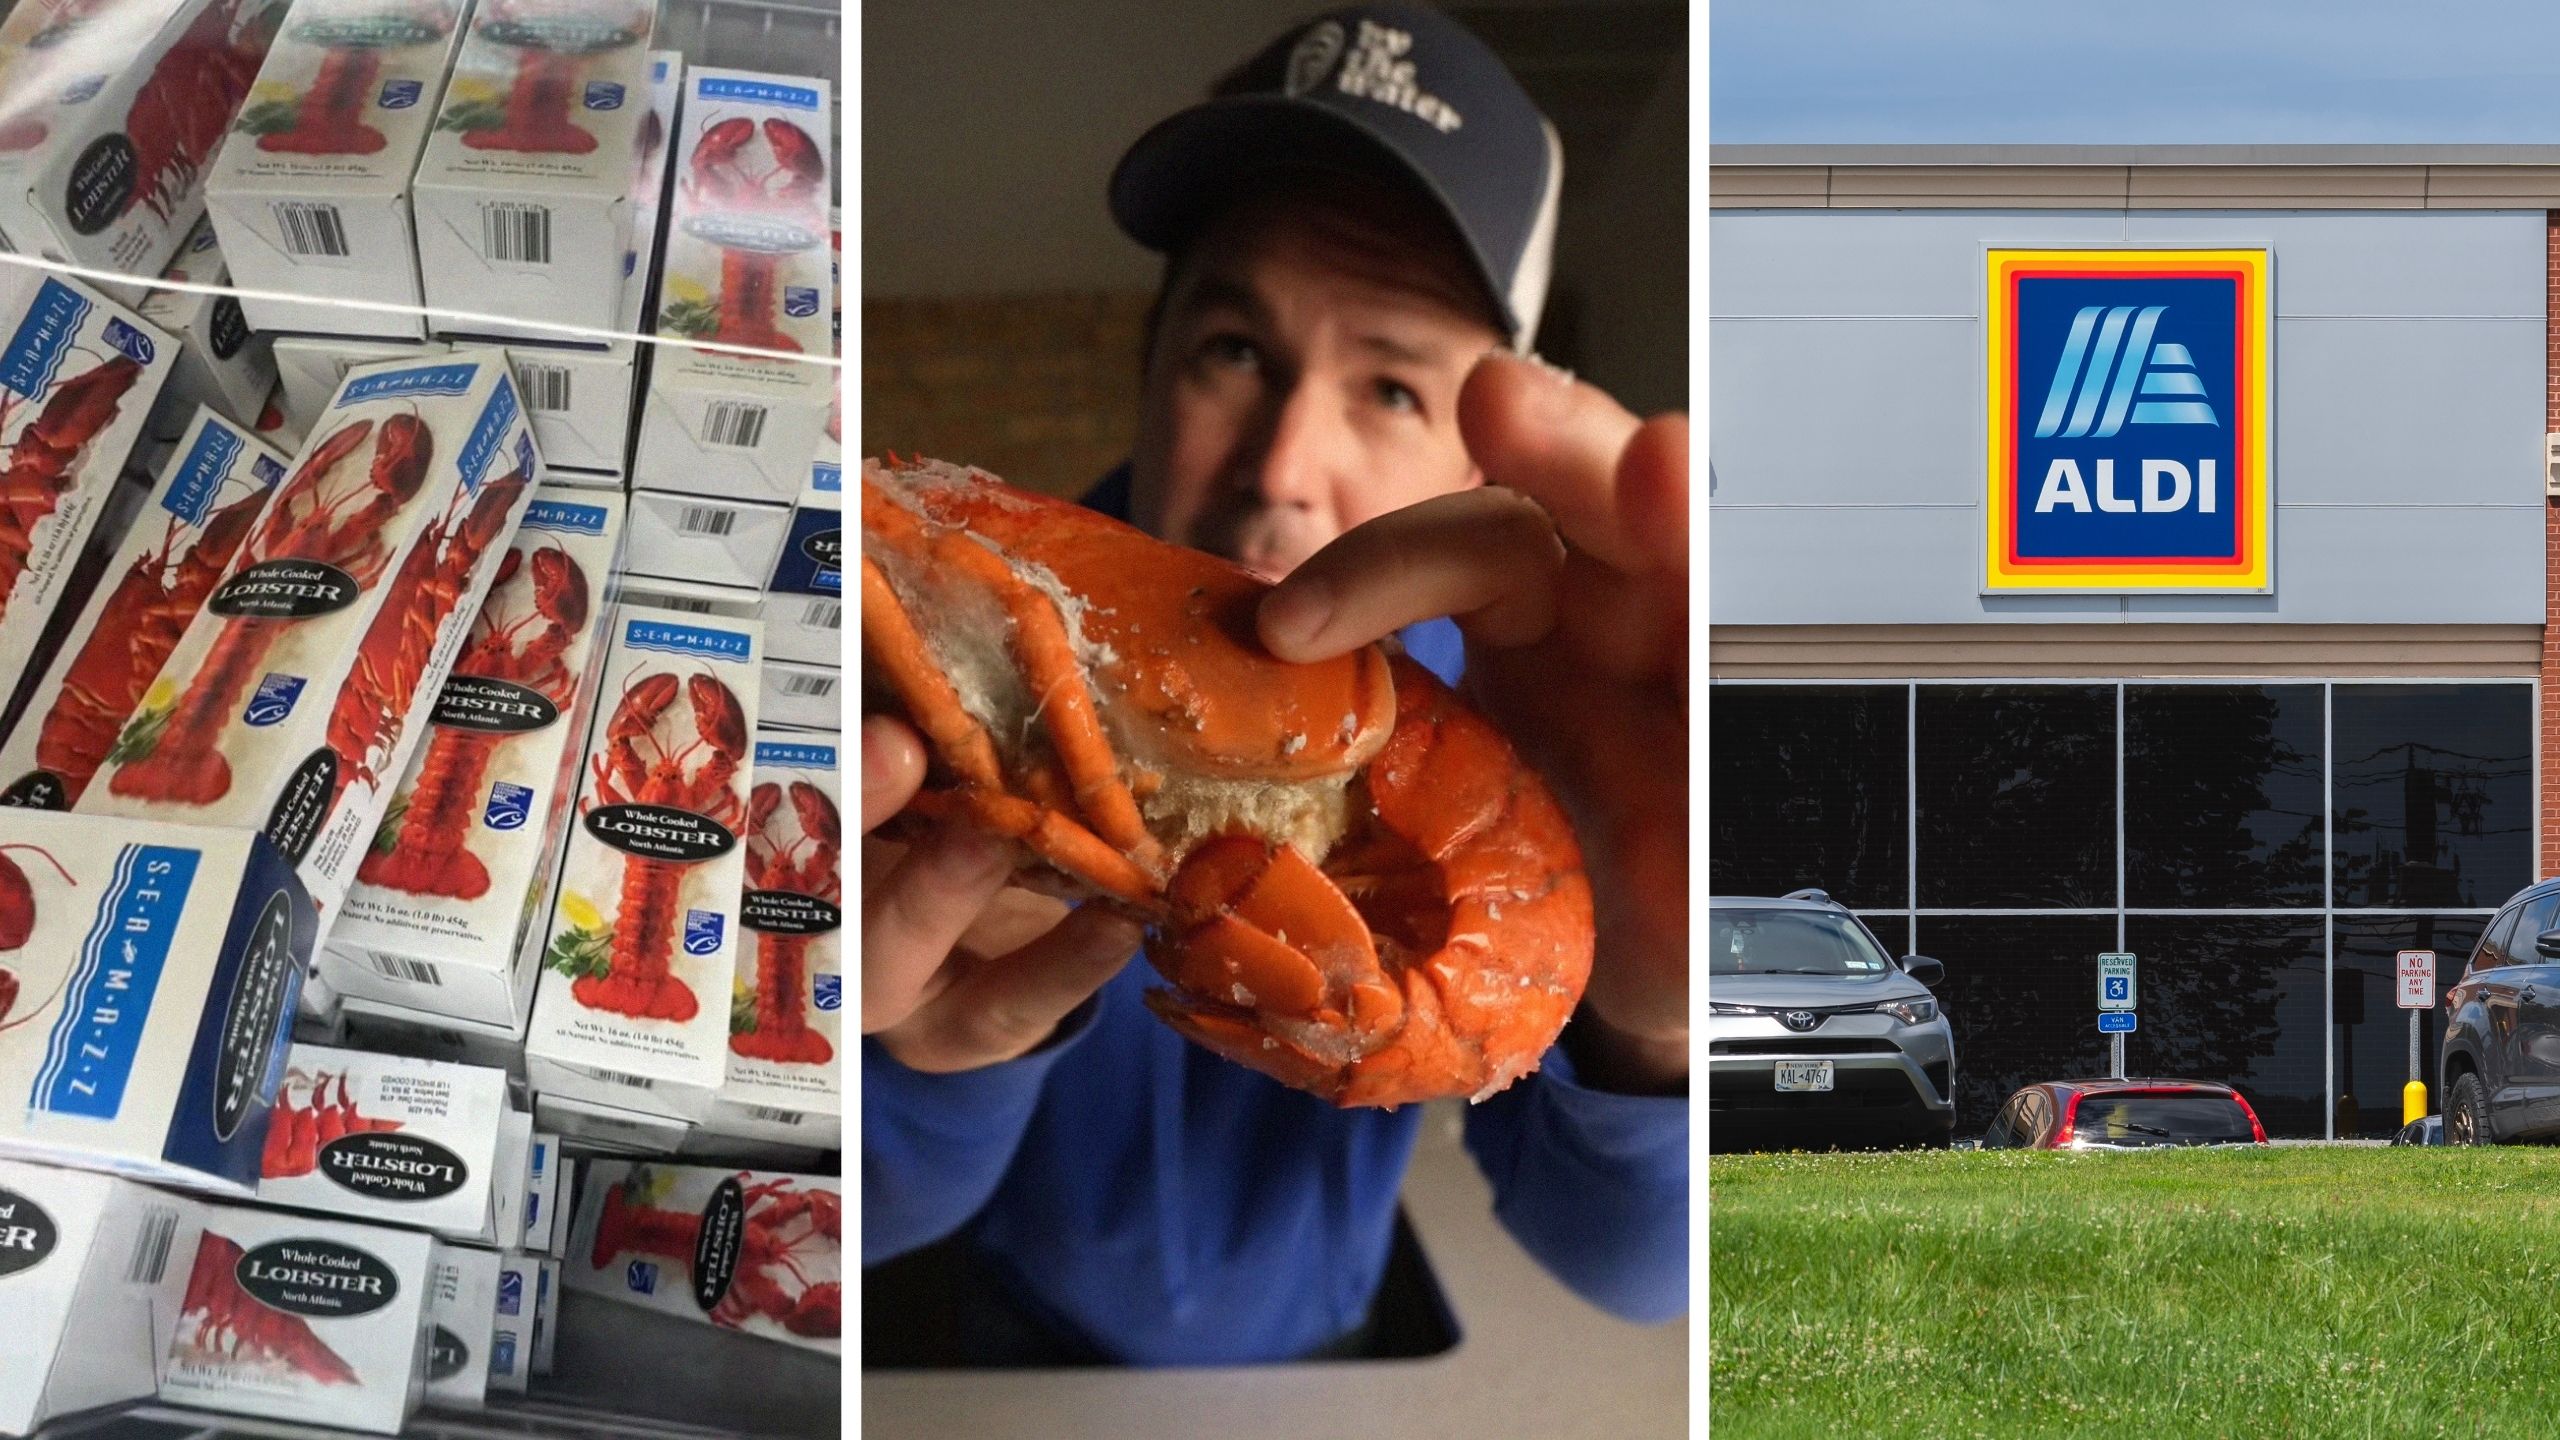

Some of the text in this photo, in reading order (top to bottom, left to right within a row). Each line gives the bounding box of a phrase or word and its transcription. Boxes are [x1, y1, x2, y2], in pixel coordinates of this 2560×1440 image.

[2034, 459, 2216, 513] ALDI
[250, 568, 324, 581] Whole Cooked
[219, 582, 341, 601] LOBSTER
[443, 682, 520, 700] Whole Cooked
[442, 710, 500, 724] North Atlantic
[270, 773, 310, 843] Whole Cooked
[625, 810, 698, 828] Whole Cooked
[597, 816, 720, 846] LOBSTER
[629, 839, 684, 854] North Atlantic
[751, 895, 813, 908] Whole Cooked
[351, 899, 365, 910] Net
[368, 902, 383, 913] Wt.
[386, 905, 396, 914] 16
[446, 915, 469, 929] 454g
[374, 915, 384, 924] No
[386, 918, 420, 930] additives
[743, 906, 833, 922] OBSTER
[2101, 958, 2132, 966] RESERVED
[2104, 967, 2130, 975] PARKING
[2409, 958, 2423, 968] NO
[2401, 969, 2431, 977] PARKING
[225, 909, 285, 1113] LOBSTER
[575, 1020, 588, 1030] Net
[608, 1027, 617, 1035] 16
[248, 1009, 271, 1077] Cooked
[368, 1139, 423, 1156] North Atlantic
[333, 1151, 455, 1182] LOBSTER
[352, 1171, 426, 1193] Whole Cooked
[704, 1189, 734, 1297] LOBSTER
[282, 1248, 360, 1270] Whole Cooked
[249, 1260, 382, 1295] LOBSTER
[281, 1289, 342, 1307] North Atlantic
